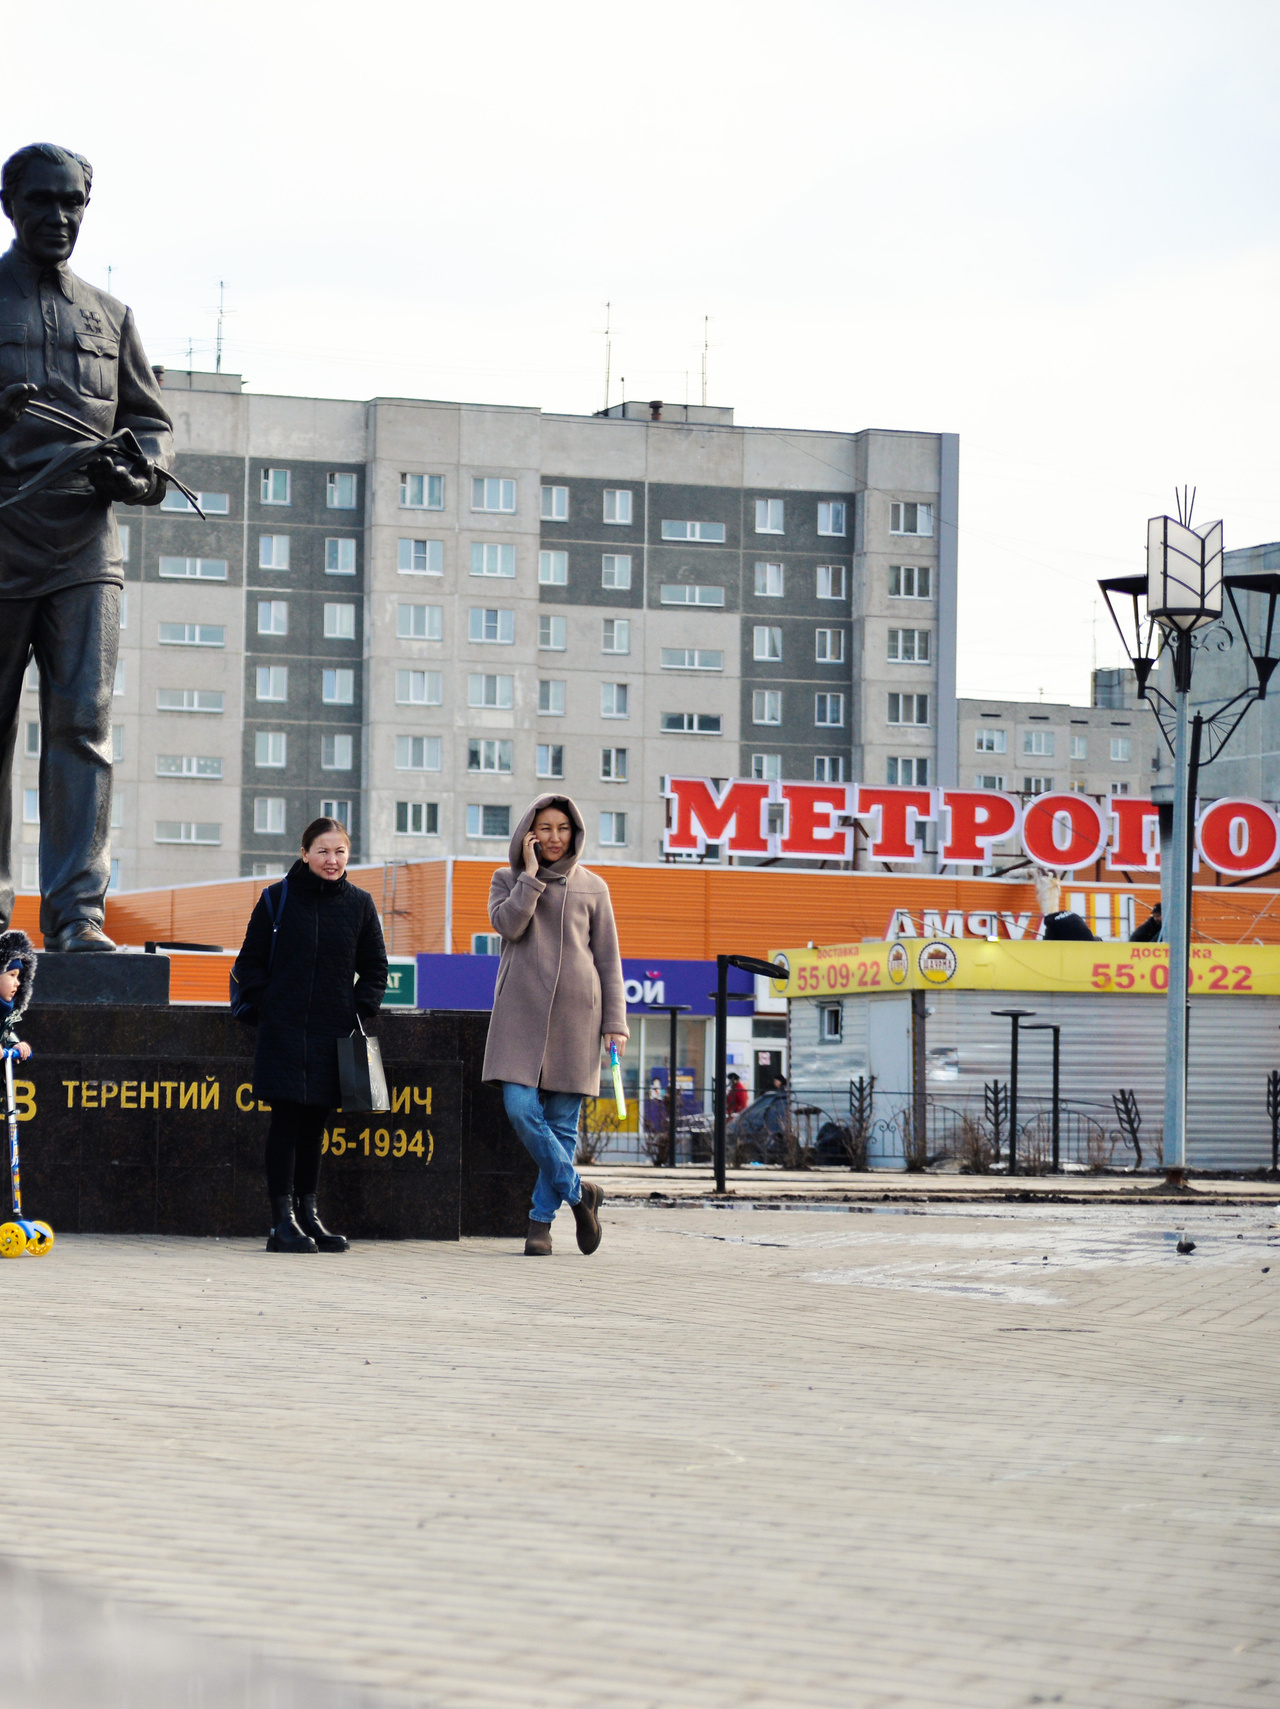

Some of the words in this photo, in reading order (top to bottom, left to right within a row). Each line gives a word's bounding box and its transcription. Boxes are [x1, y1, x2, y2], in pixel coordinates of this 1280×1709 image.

[816, 947, 859, 961] доставка
[1130, 947, 1212, 960] достка
[62, 1075, 220, 1110] ТЕРЕНТИЙ
